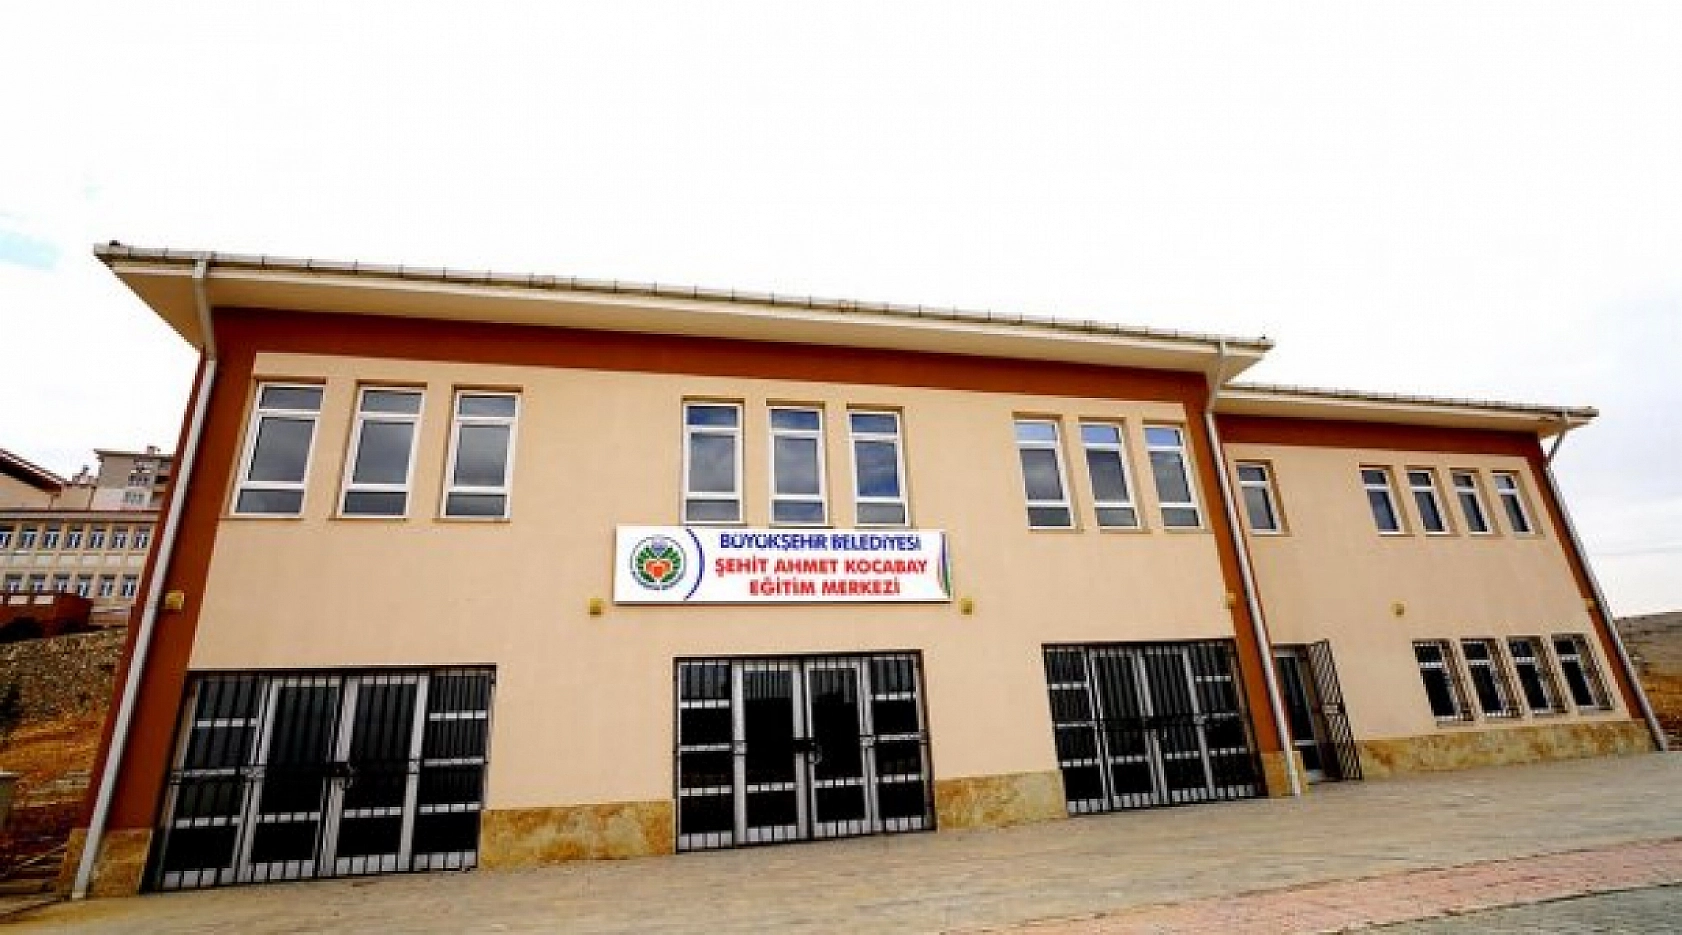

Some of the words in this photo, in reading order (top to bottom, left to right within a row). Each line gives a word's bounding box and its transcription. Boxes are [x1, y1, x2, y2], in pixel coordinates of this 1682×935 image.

[715, 555, 768, 577] ŞEHİT
[774, 558, 838, 573] AHMET
[845, 558, 928, 573] KOCABAY
[749, 576, 815, 596] EĞİTİM
[822, 576, 900, 595] MERKEZİ
